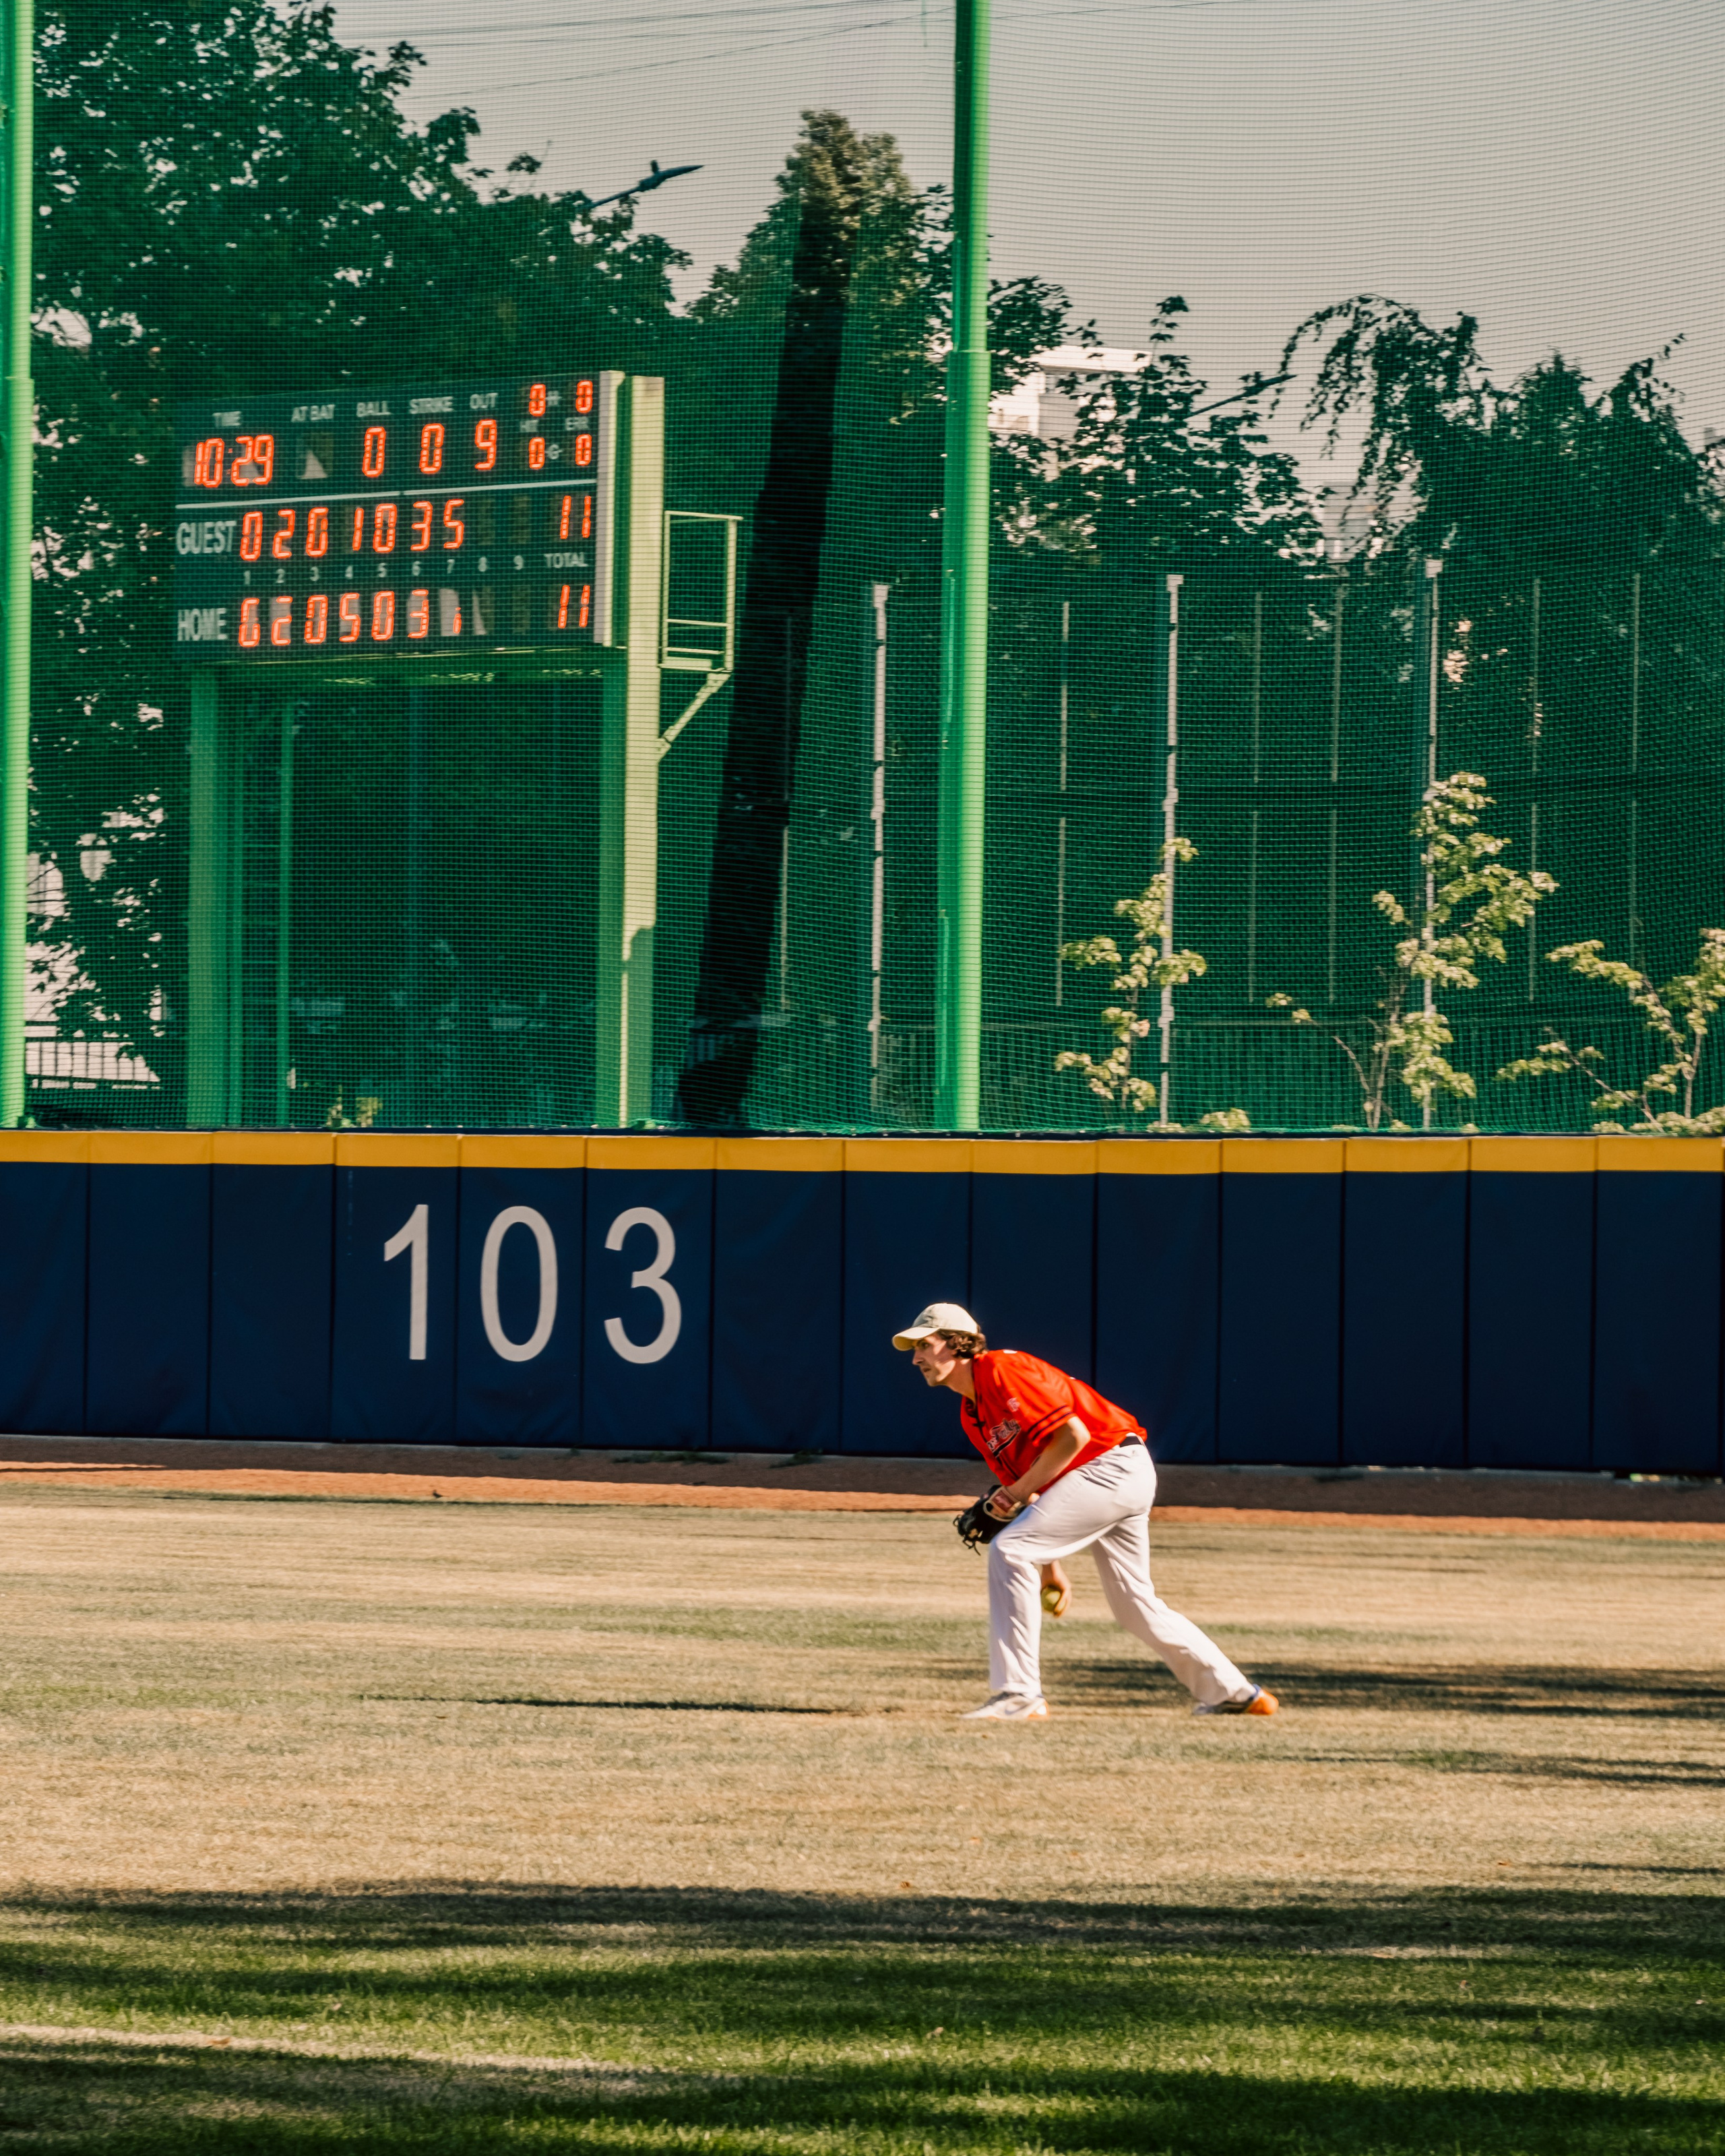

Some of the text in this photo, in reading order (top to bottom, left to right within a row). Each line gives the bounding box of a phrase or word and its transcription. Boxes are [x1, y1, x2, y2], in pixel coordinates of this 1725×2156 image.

[290, 404, 336, 422] AT BAT
[356, 401, 391, 417] BALL
[470, 393, 498, 410] OUT
[529, 384, 546, 416] 0
[575, 380, 593, 413] 0
[362, 426, 386, 478] 0
[419, 423, 445, 474] 0
[474, 418, 497, 470] 9
[529, 437, 545, 470] 0
[575, 434, 592, 466] 0
[176, 520, 236, 555] GUEST
[240, 511, 263, 561] 0
[272, 509, 295, 559] 2
[372, 503, 397, 552] 0
[410, 501, 433, 551] 3
[443, 499, 464, 548] 5
[560, 495, 592, 539] 11
[276, 568, 286, 584] 2
[310, 566, 320, 582] 3
[544, 552, 588, 568] TOTAL
[558, 585, 590, 629] 11
[177, 608, 228, 641] HOME
[384, 1204, 682, 1364] 103
